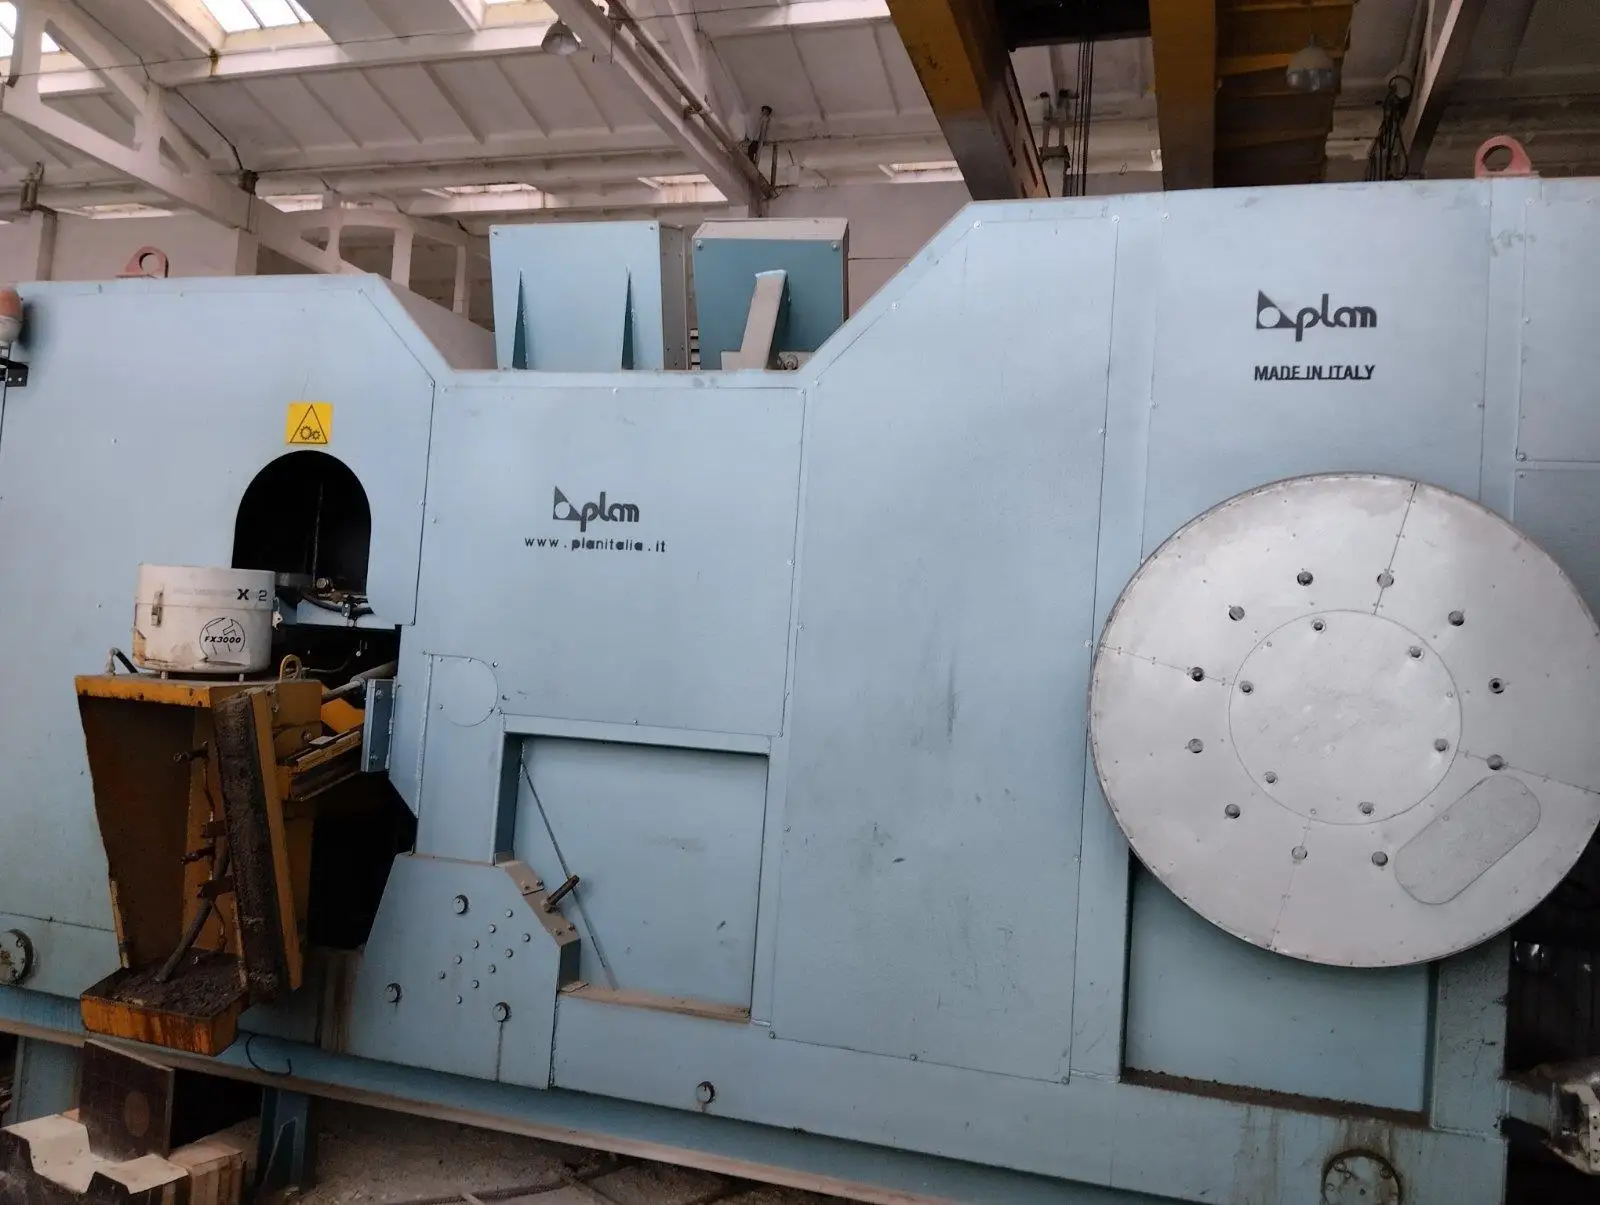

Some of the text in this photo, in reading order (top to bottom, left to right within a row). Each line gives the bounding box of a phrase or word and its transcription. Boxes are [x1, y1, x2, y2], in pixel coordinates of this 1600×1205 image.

[1254, 364, 1376, 381] MADE IN ITALY
[203, 635, 242, 644] FX3000
